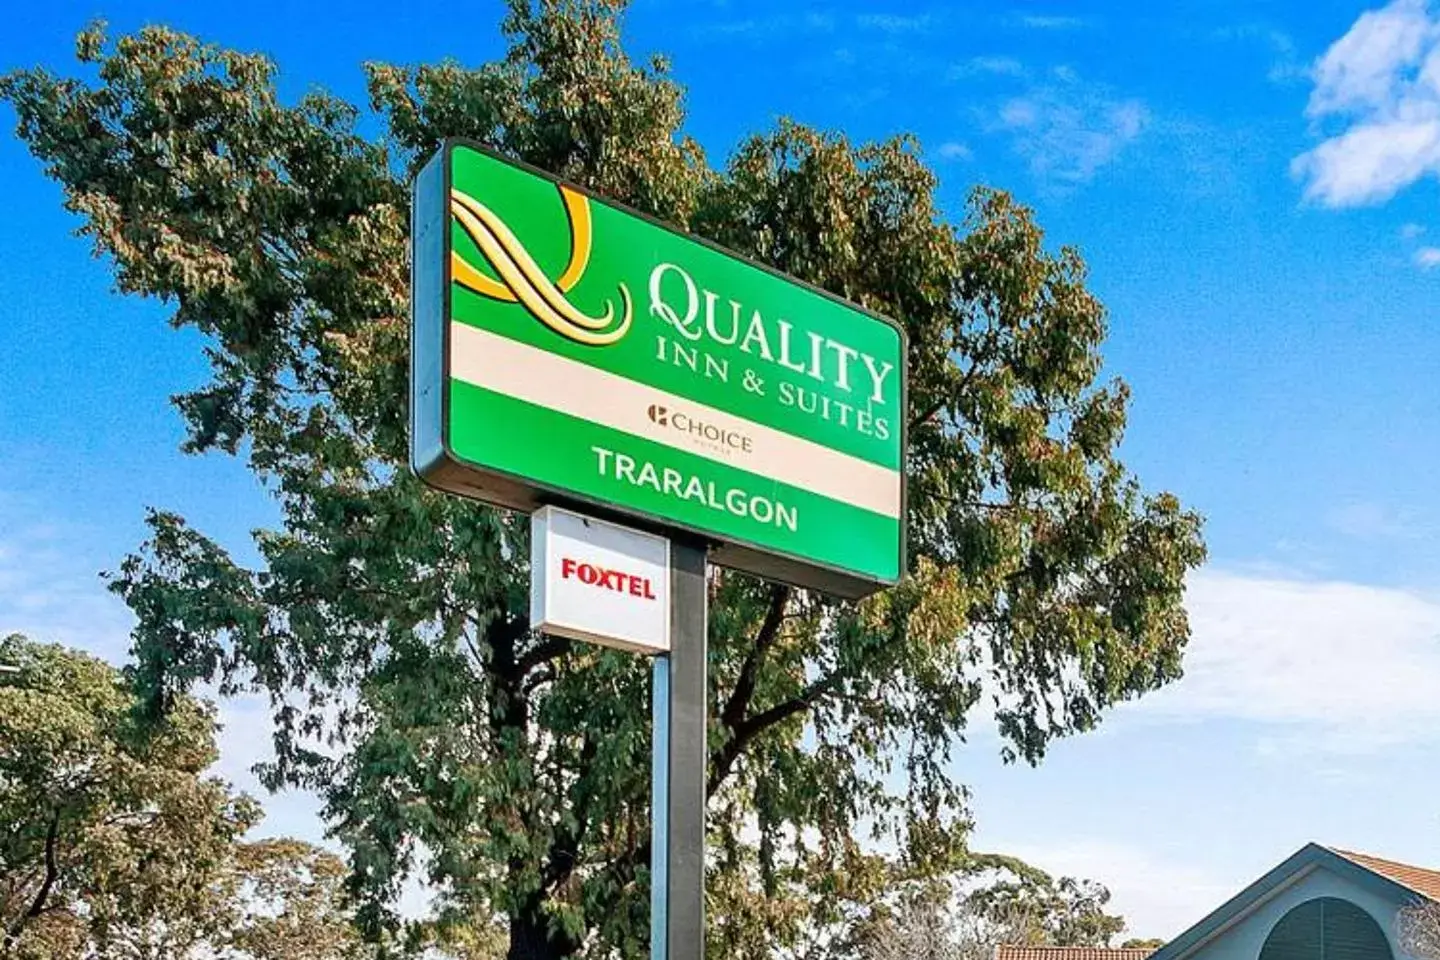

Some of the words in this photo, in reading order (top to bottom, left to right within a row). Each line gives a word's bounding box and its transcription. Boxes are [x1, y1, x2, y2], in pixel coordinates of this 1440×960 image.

[649, 263, 893, 404] QUALITY
[656, 336, 728, 382] INN
[742, 369, 765, 396] &
[779, 382, 890, 440] SUITES
[671, 412, 752, 453] CHOICE
[592, 446, 798, 532] TRARALGON
[561, 558, 656, 600] FOXTEL
